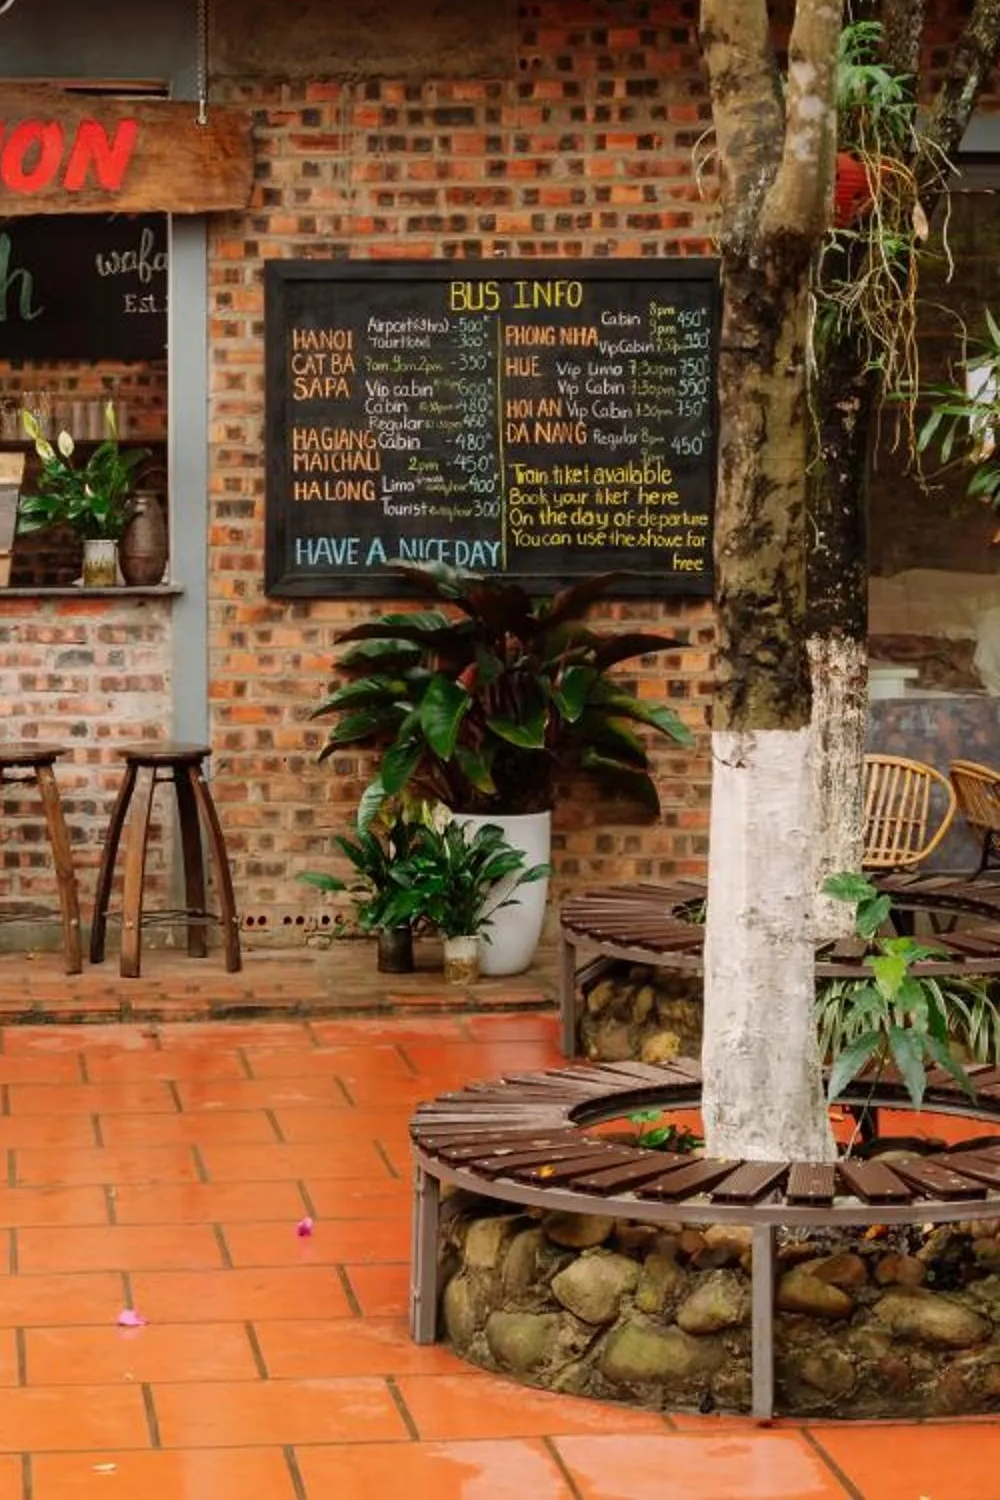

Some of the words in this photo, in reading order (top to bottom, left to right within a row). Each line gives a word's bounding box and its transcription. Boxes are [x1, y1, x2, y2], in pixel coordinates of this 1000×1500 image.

[450, 281, 500, 311] BUS
[513, 280, 583, 309] INFO
[601, 311, 641, 326] Cabin
[293, 328, 353, 351] HANOI
[505, 325, 556, 347] PHONG
[560, 325, 599, 348] NHA
[291, 353, 327, 375] CAT
[331, 352, 355, 375] BA
[505, 356, 541, 377] HUE
[293, 377, 350, 400] SAPA
[585, 378, 625, 396] Cabin
[506, 399, 533, 418] HOI
[537, 398, 562, 418] AN
[535, 420, 587, 445] NANG
[594, 460, 673, 486] available
[510, 488, 548, 506] Book
[638, 486, 680, 506] here
[509, 508, 533, 526] On
[539, 506, 568, 526] the
[571, 508, 609, 530] day
[295, 537, 361, 565] HAVE
[365, 536, 388, 566] A
[455, 540, 501, 568] DAY
